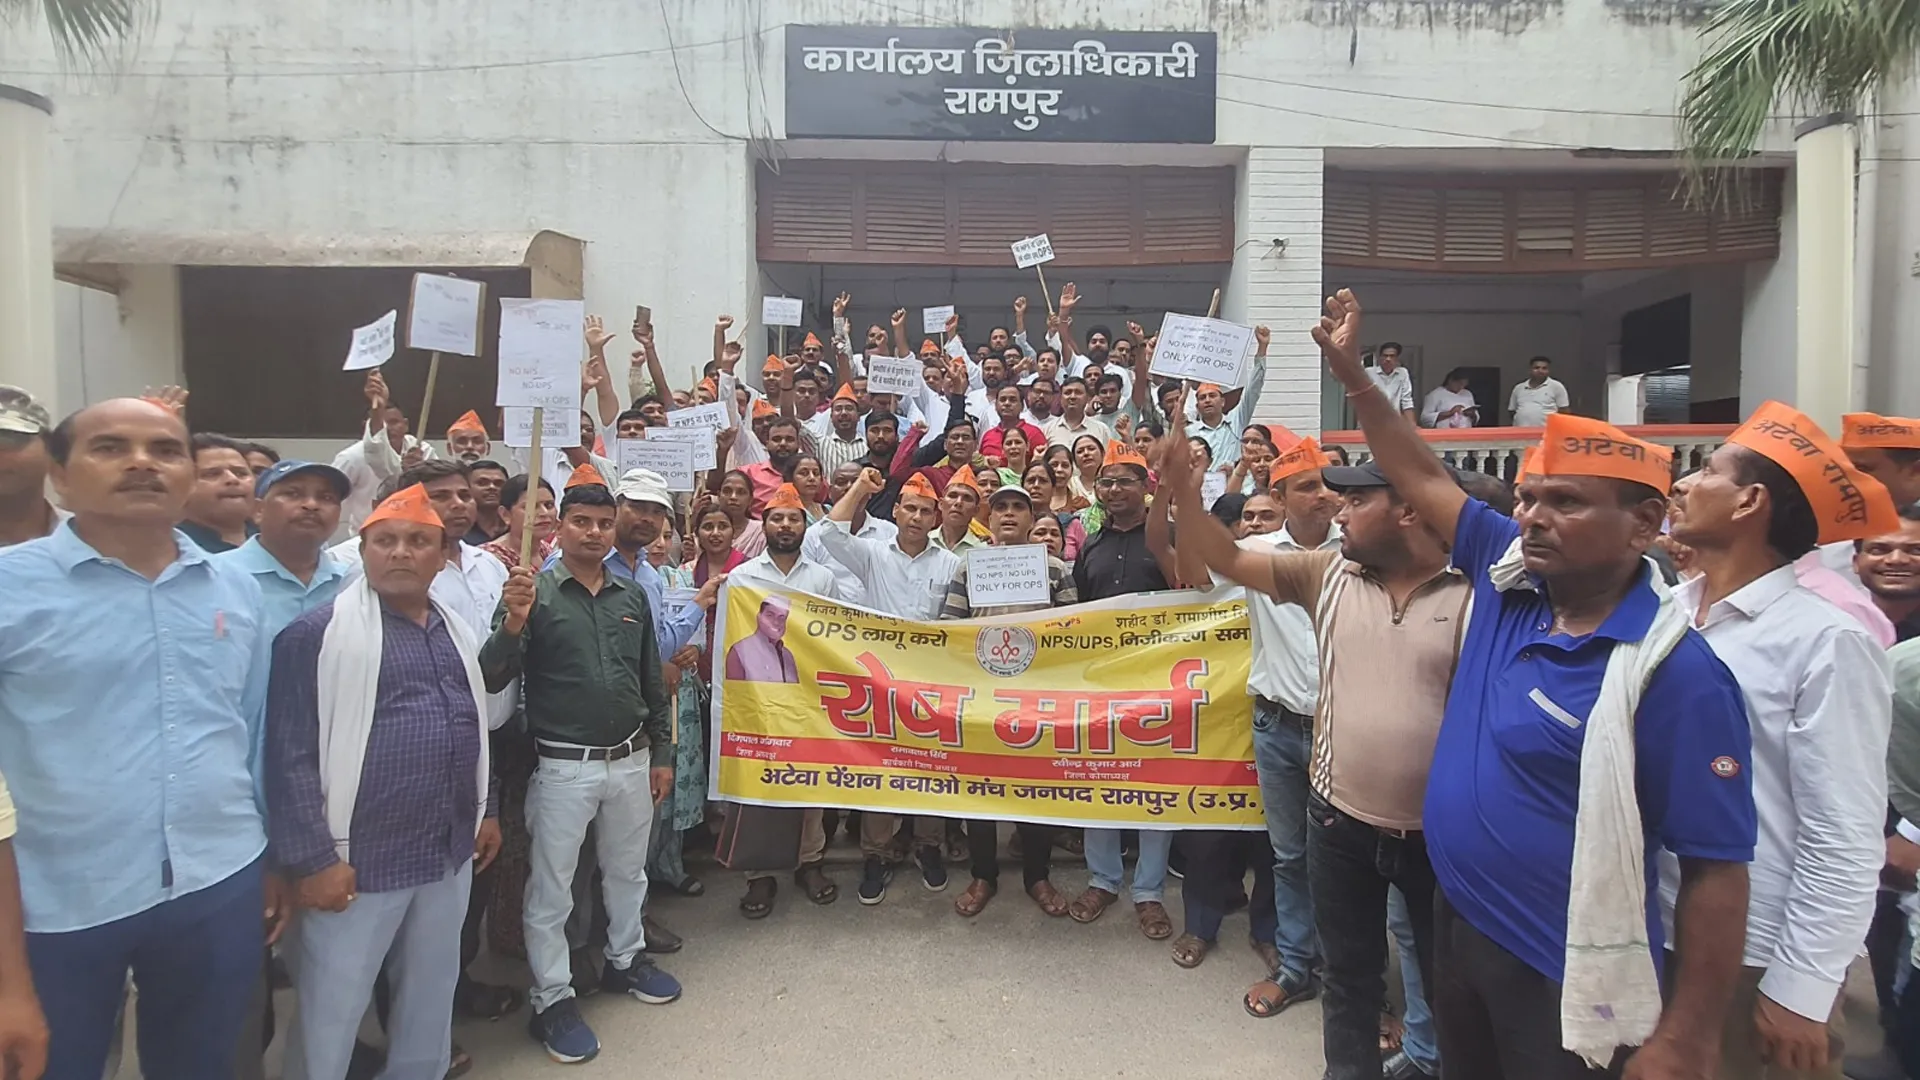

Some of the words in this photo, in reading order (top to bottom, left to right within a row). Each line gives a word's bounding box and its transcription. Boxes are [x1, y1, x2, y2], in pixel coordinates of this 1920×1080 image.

[802, 38, 966, 77] कार्यालय
[973, 38, 1200, 86] ज़िलाधिकारी
[943, 88, 1064, 131] रामपुर
[1037, 245, 1052, 258] OPS
[1181, 342, 1197, 350] NPS
[1202, 345, 1214, 353] NO
[1216, 347, 1233, 356] UPS
[1162, 350, 1188, 362] ONLY
[1190, 356, 1211, 367] FOR
[1213, 359, 1235, 371] OPS
[681, 417, 695, 427] NPS
[703, 412, 719, 423] UPS
[1752, 419, 1824, 457] अटेवा
[1116, 444, 1139, 457] OPS
[1563, 432, 1646, 463] अटेवा
[670, 470, 688, 478] OPS
[988, 571, 1003, 579] NPS
[975, 582, 1000, 592] ONLY
[1002, 581, 1021, 591] FOR
[1023, 580, 1043, 590] OPS
[806, 600, 838, 616] विजय
[1115, 613, 1148, 629] शहीद
[1151, 611, 1170, 626] डॉ.
[806, 620, 857, 642] OPS
[862, 626, 907, 650] लागू
[909, 629, 949, 647] करो
[816, 651, 974, 747] रोष
[993, 658, 1211, 754] मार्च
[1052, 757, 1083, 768] रवीन्द्र
[1086, 760, 1117, 772] कुमार
[1118, 758, 1142, 769] आर्य
[1064, 770, 1086, 780] जिला
[760, 764, 820, 787] अटेवा
[826, 766, 884, 790] पेंशन
[889, 774, 962, 795] बचाओ
[967, 778, 1006, 797] मंच
[1012, 784, 1095, 804] जनपद
[1100, 787, 1180, 815] रामपुर
